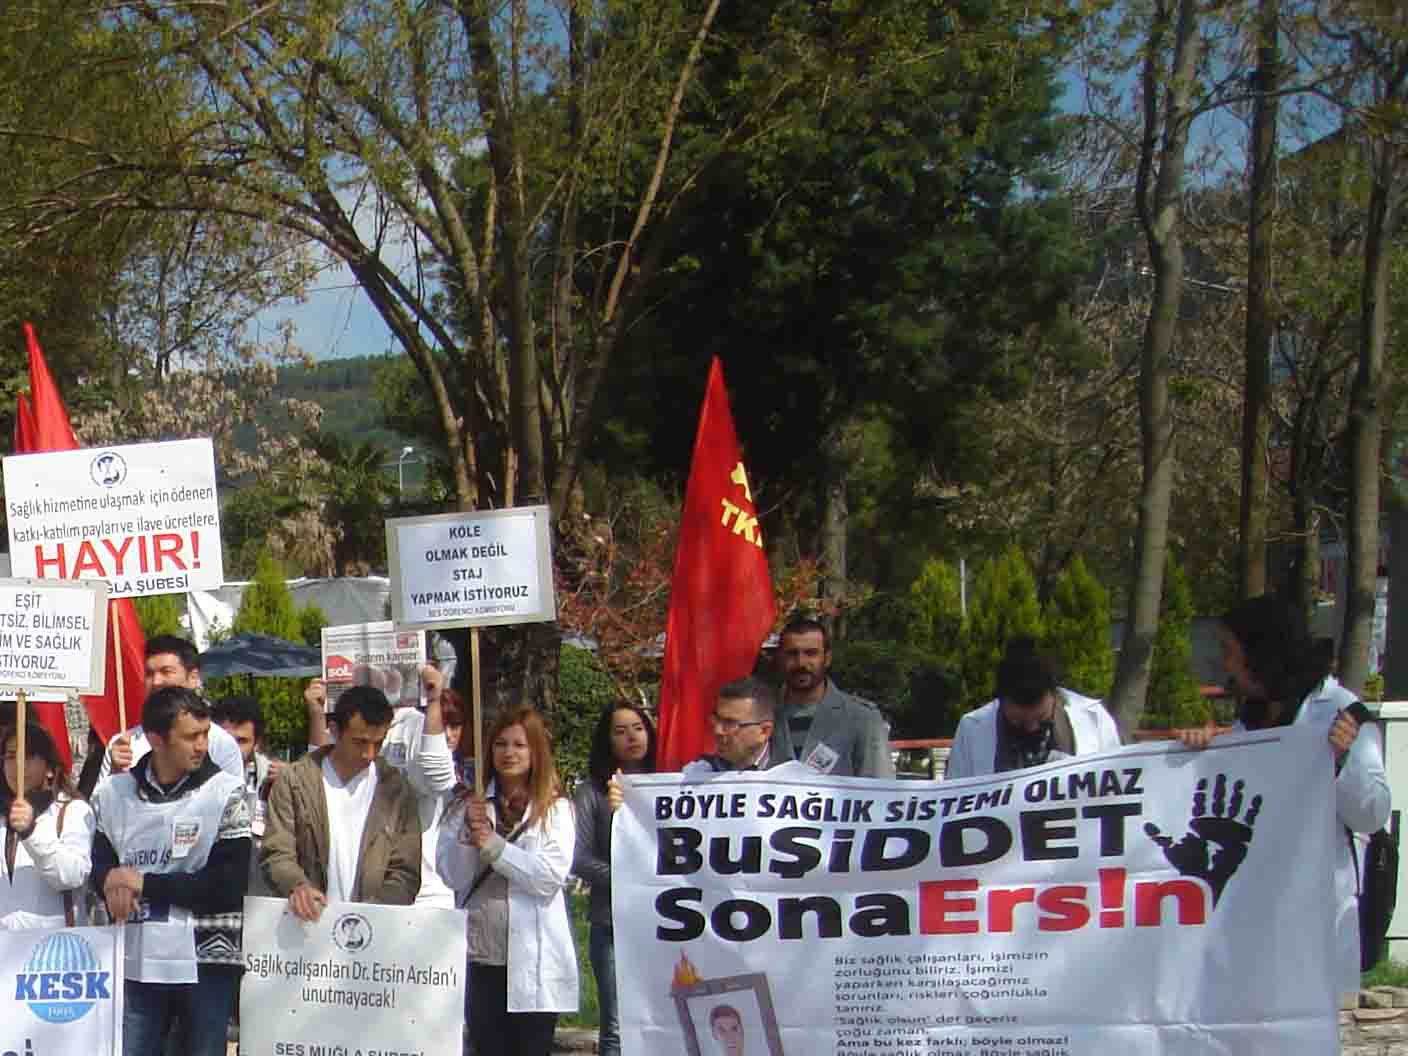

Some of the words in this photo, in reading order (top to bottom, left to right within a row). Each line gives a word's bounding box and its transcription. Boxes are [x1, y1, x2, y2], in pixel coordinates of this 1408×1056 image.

[10, 501, 42, 519] Sağlık
[120, 521, 134, 532] ve
[35, 531, 201, 581] HAYIR!
[425, 550, 468, 562] OLMAK
[471, 545, 507, 559] DEĞİL
[452, 568, 482, 581] STAJ
[137, 574, 189, 594] ŞUBESİ
[410, 590, 461, 606] YAPMAK
[16, 634, 32, 648] VE
[655, 791, 746, 820] BÖYLE
[757, 793, 872, 822] SAĞLIK
[1024, 767, 1144, 802] OLMAZ
[247, 954, 283, 978] Sağlık
[284, 959, 351, 981] çalışanları
[352, 961, 370, 981] Dr.
[372, 964, 405, 984] Ersin
[15, 972, 110, 1000] KESK
[302, 988, 396, 1009] unutmayacak!
[275, 1042, 305, 1056] SES
